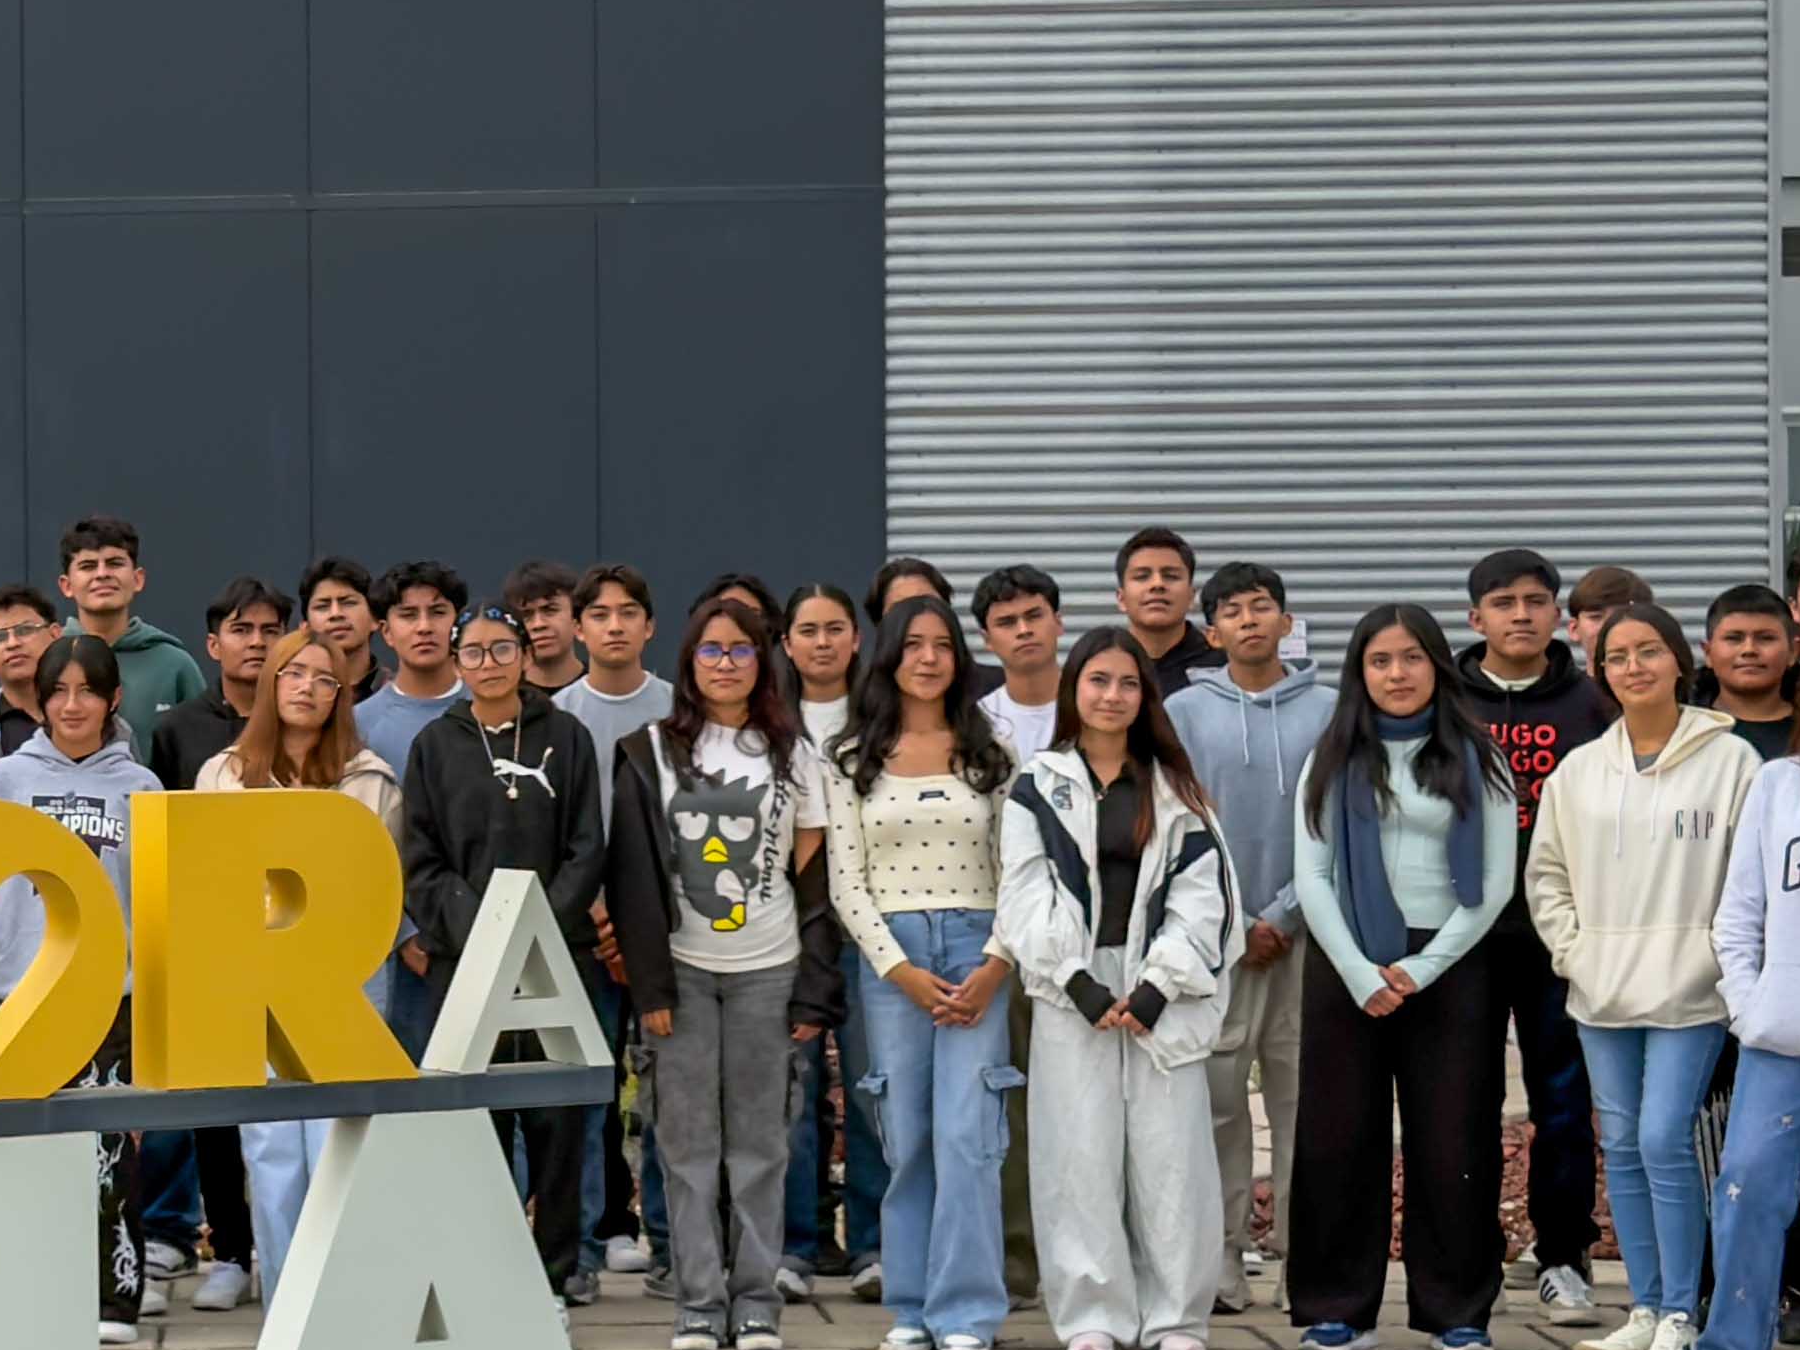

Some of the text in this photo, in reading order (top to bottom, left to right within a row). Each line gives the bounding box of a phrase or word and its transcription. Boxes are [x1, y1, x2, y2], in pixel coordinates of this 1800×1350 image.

[1489, 723, 1556, 747] UGO
[1510, 750, 1555, 773] GO
[1675, 809, 1715, 841] GAP
[419, 867, 616, 1075] A
